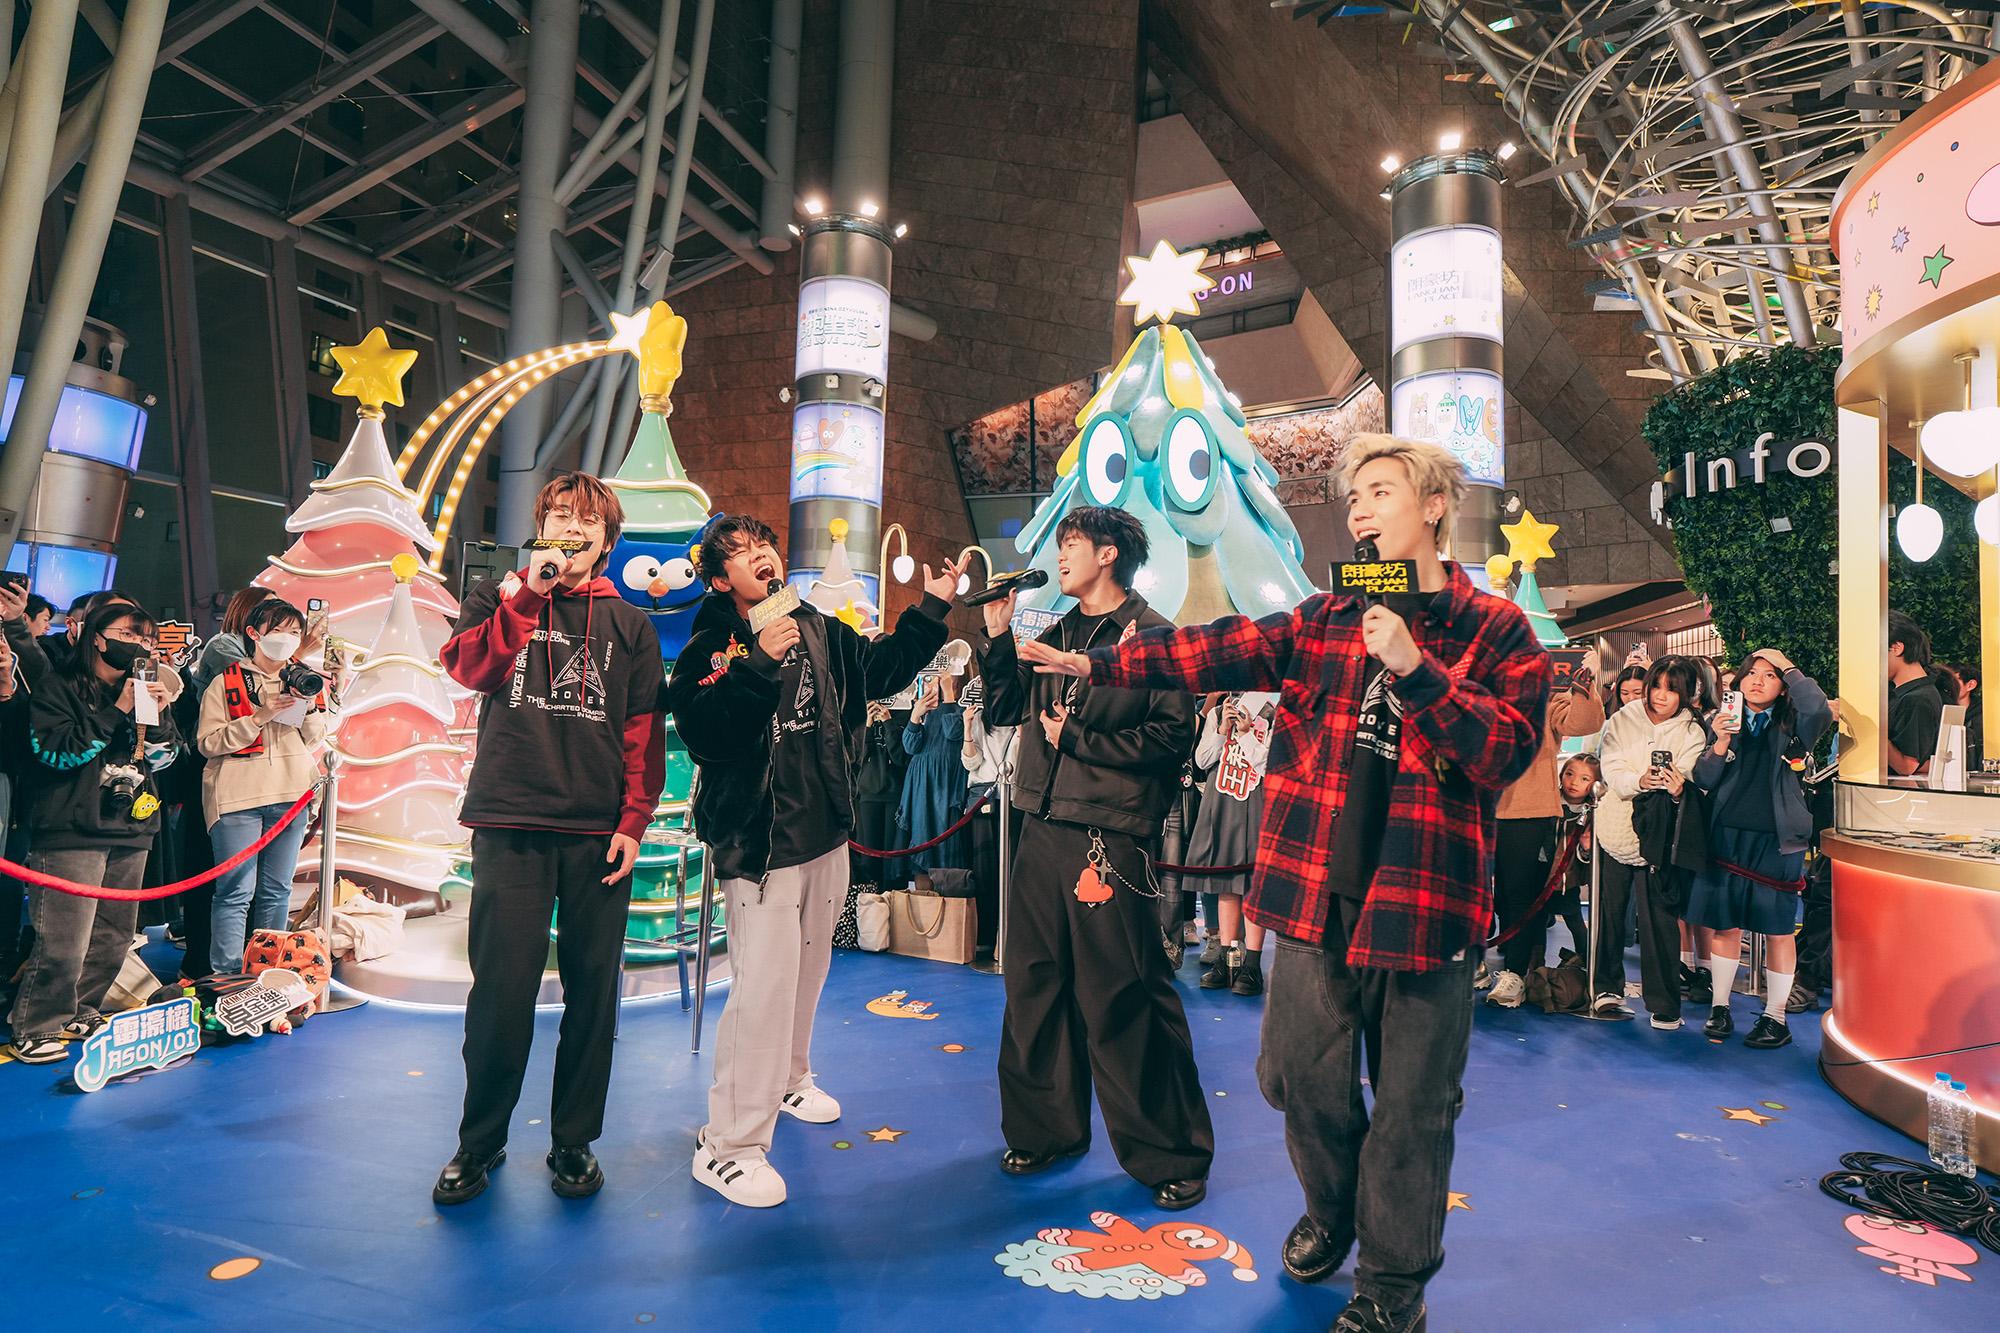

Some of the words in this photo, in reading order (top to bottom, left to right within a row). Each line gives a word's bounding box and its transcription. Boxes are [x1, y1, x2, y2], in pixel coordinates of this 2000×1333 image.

[1685, 432, 1831, 498] Info
[1342, 577, 1409, 587] LANGHAM
[1365, 585, 1409, 593] PLACE
[510, 672, 525, 701] VOICES
[526, 694, 546, 704] THE
